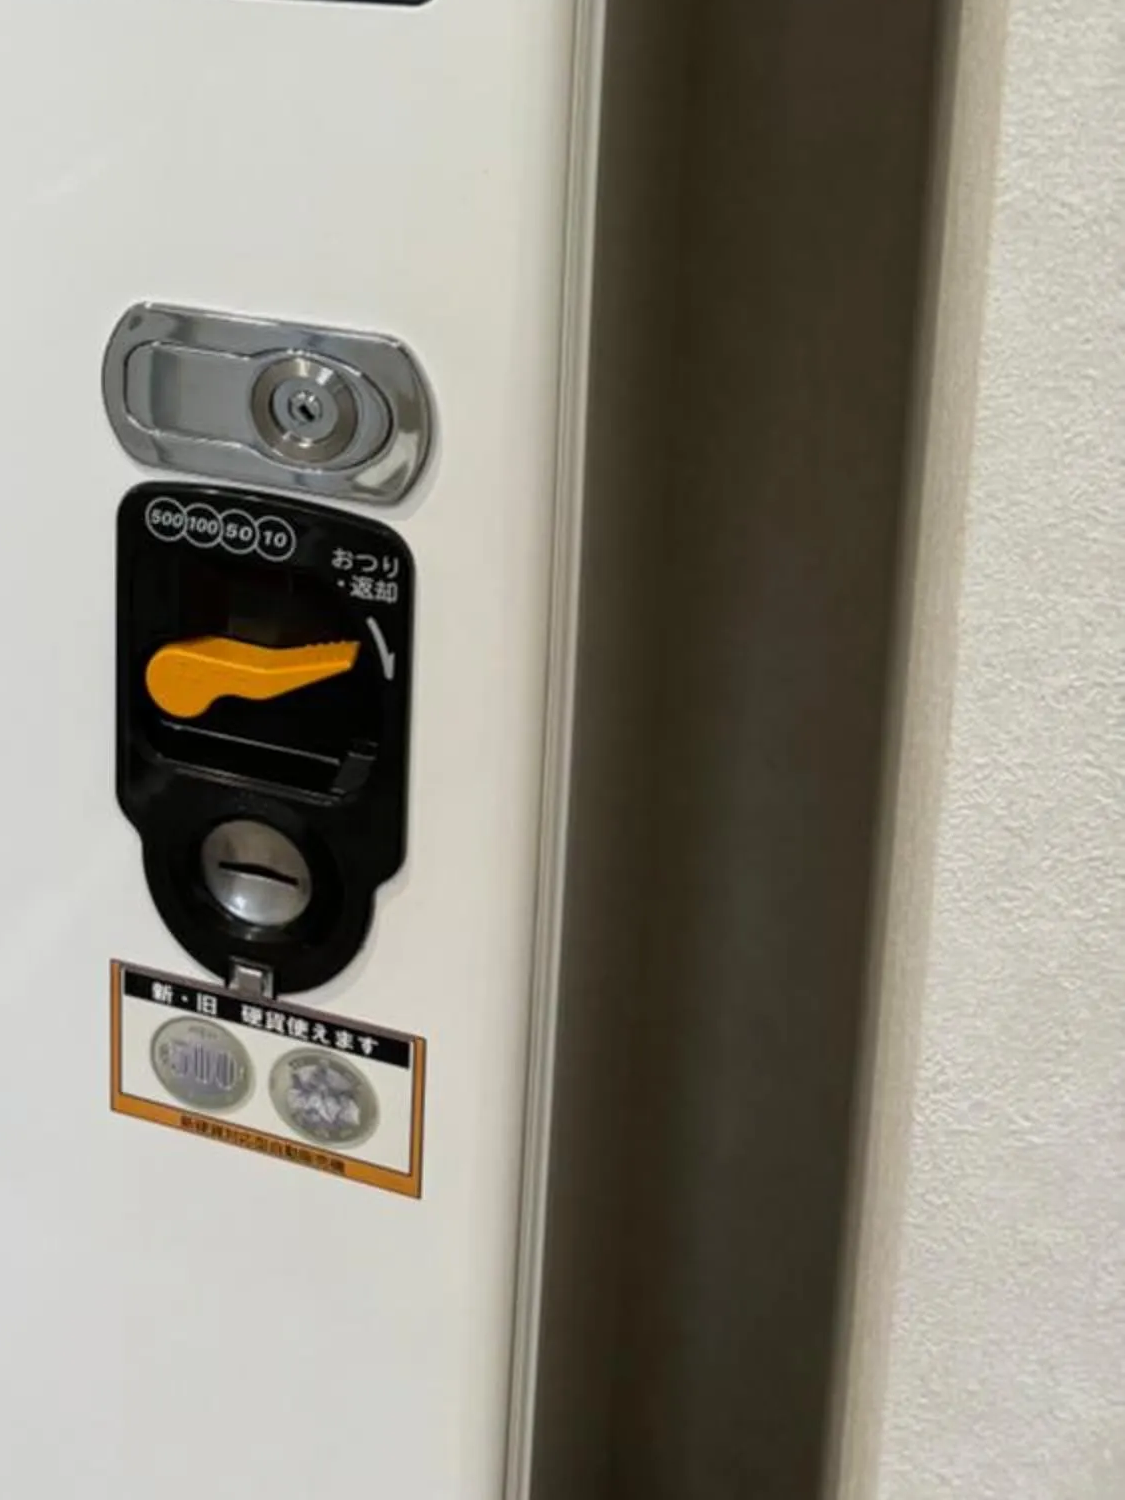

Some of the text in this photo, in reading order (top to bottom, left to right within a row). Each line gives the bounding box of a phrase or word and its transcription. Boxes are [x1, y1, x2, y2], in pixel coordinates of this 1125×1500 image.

[151, 508, 288, 549] 500 100 50 10
[331, 548, 399, 579] おつり
